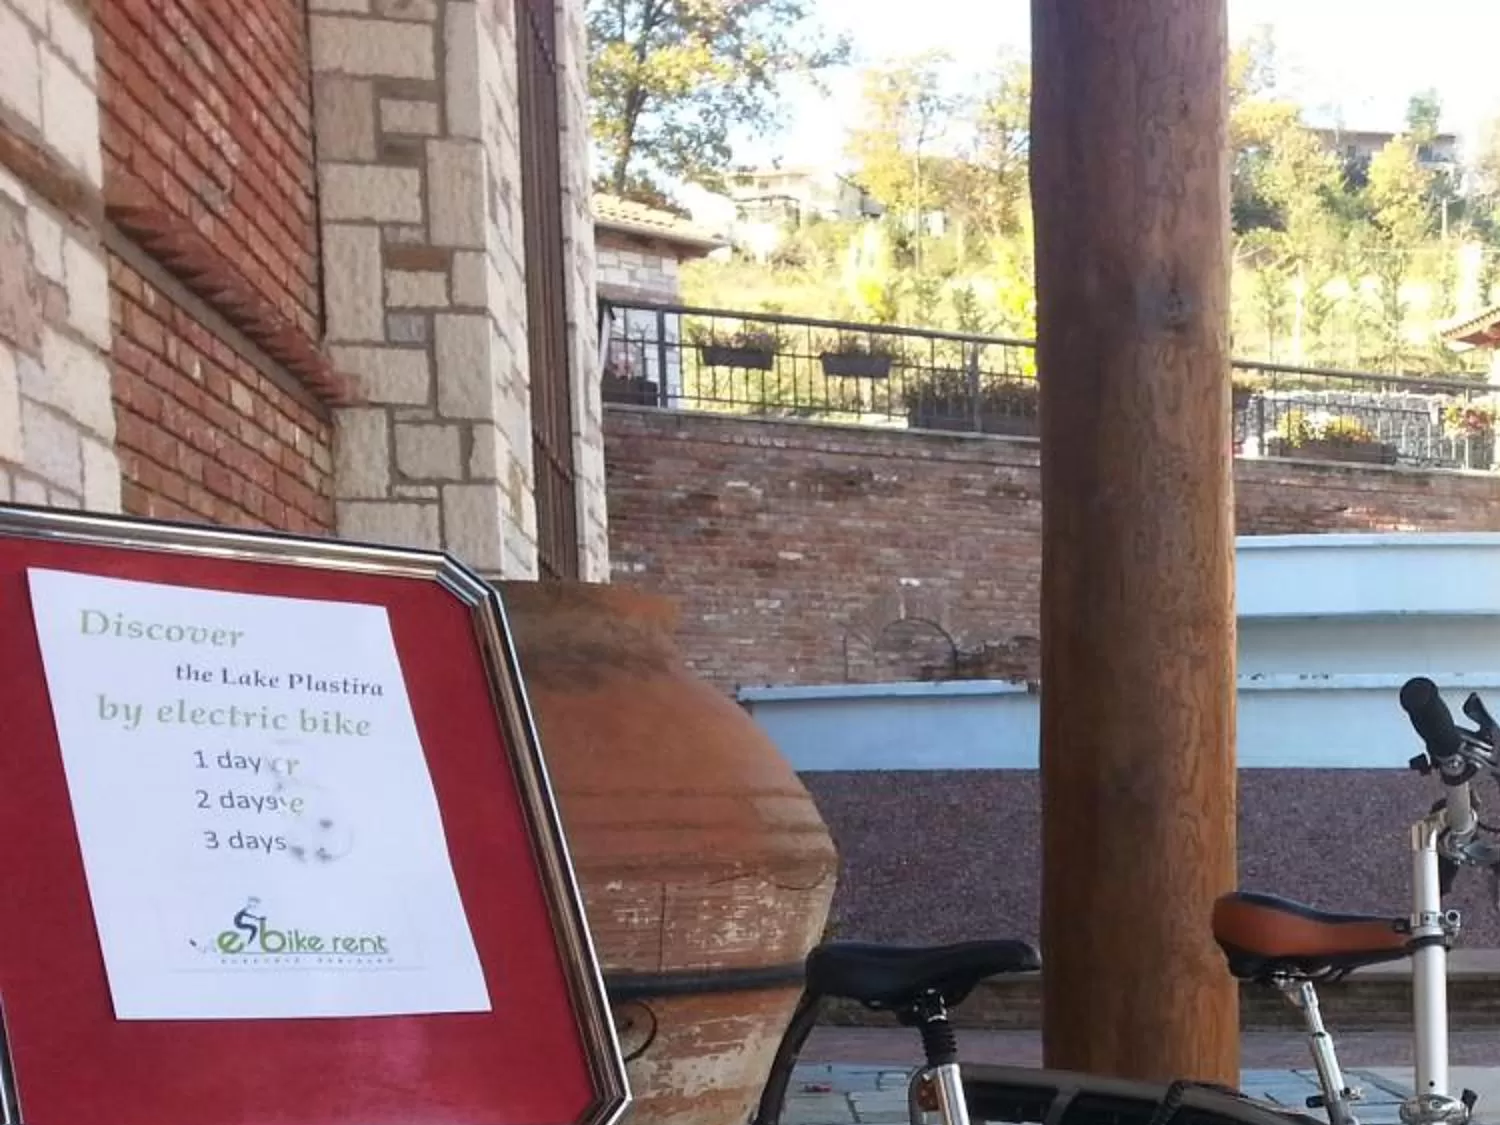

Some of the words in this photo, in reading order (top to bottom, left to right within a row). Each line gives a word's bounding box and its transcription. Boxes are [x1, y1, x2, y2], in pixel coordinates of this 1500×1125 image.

[80, 608, 244, 648] Discover
[176, 663, 213, 684] the
[221, 666, 280, 689] Lake
[288, 672, 384, 697] Plastira
[97, 693, 143, 730] by
[156, 698, 288, 731] electric
[299, 708, 371, 737] bike
[193, 750, 208, 769] 1
[216, 749, 262, 774] day
[195, 789, 211, 809] 2
[203, 830, 219, 849] 3
[228, 829, 288, 854] days
[332, 934, 389, 953] rent
